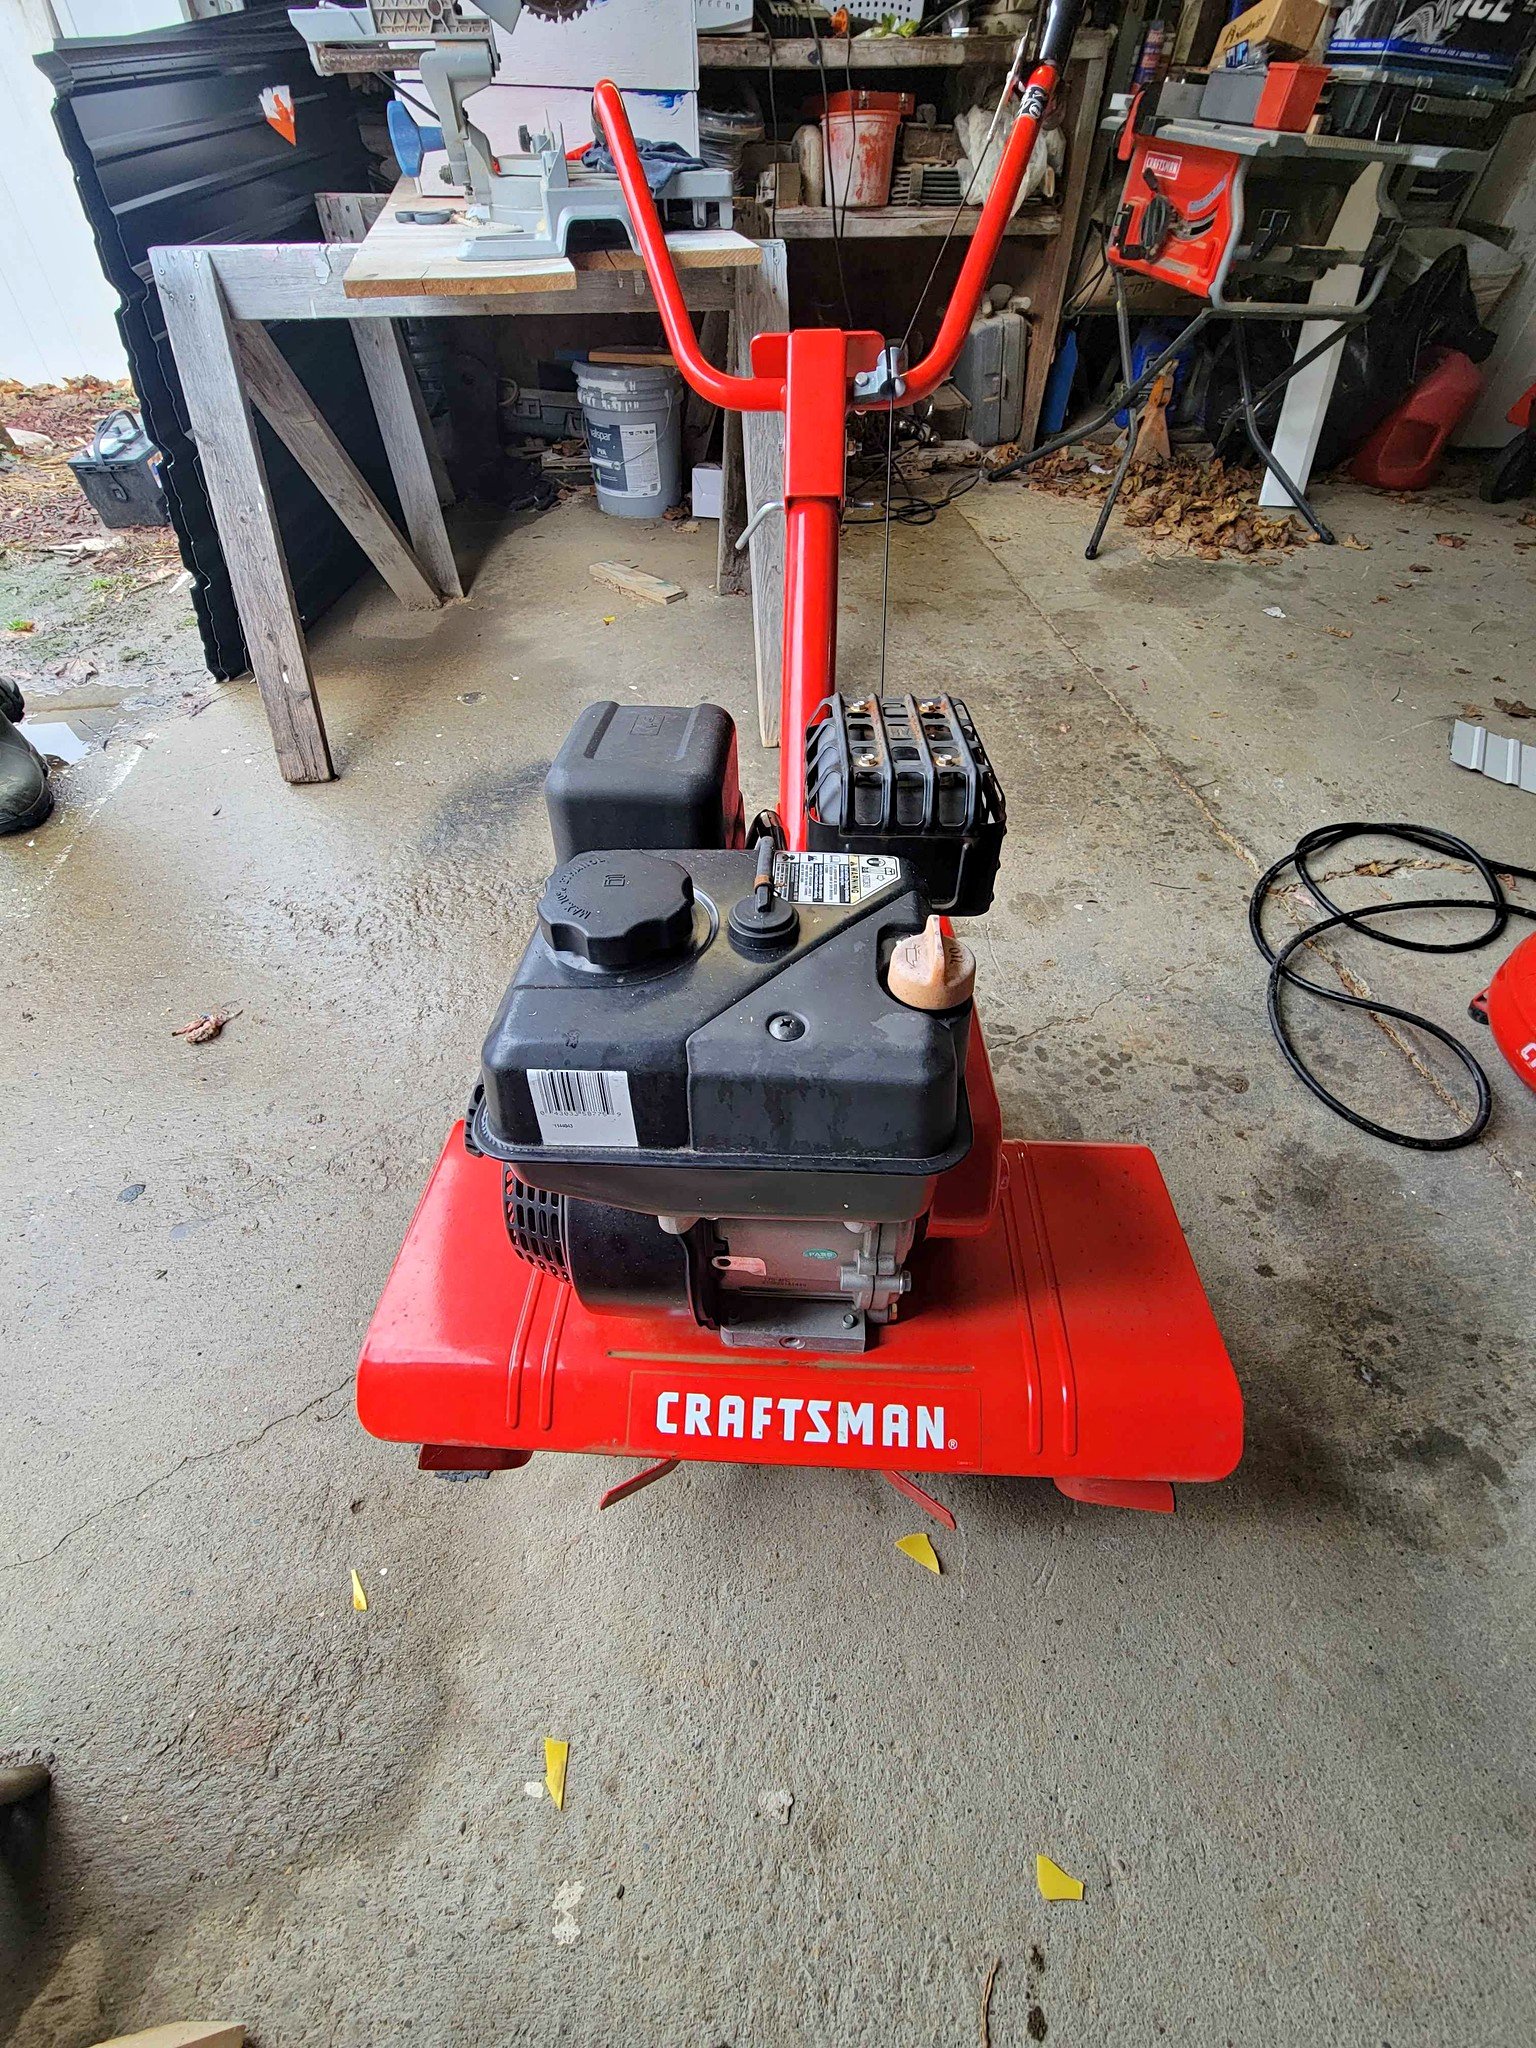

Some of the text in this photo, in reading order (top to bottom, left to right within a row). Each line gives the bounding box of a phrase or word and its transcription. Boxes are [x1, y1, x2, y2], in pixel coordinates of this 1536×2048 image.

[1146, 156, 1179, 174] CRAFTSMAN
[851, 867, 859, 894] WARNING
[949, 947, 964, 965] OIL
[656, 1391, 945, 1450] CRAFTSMAN
